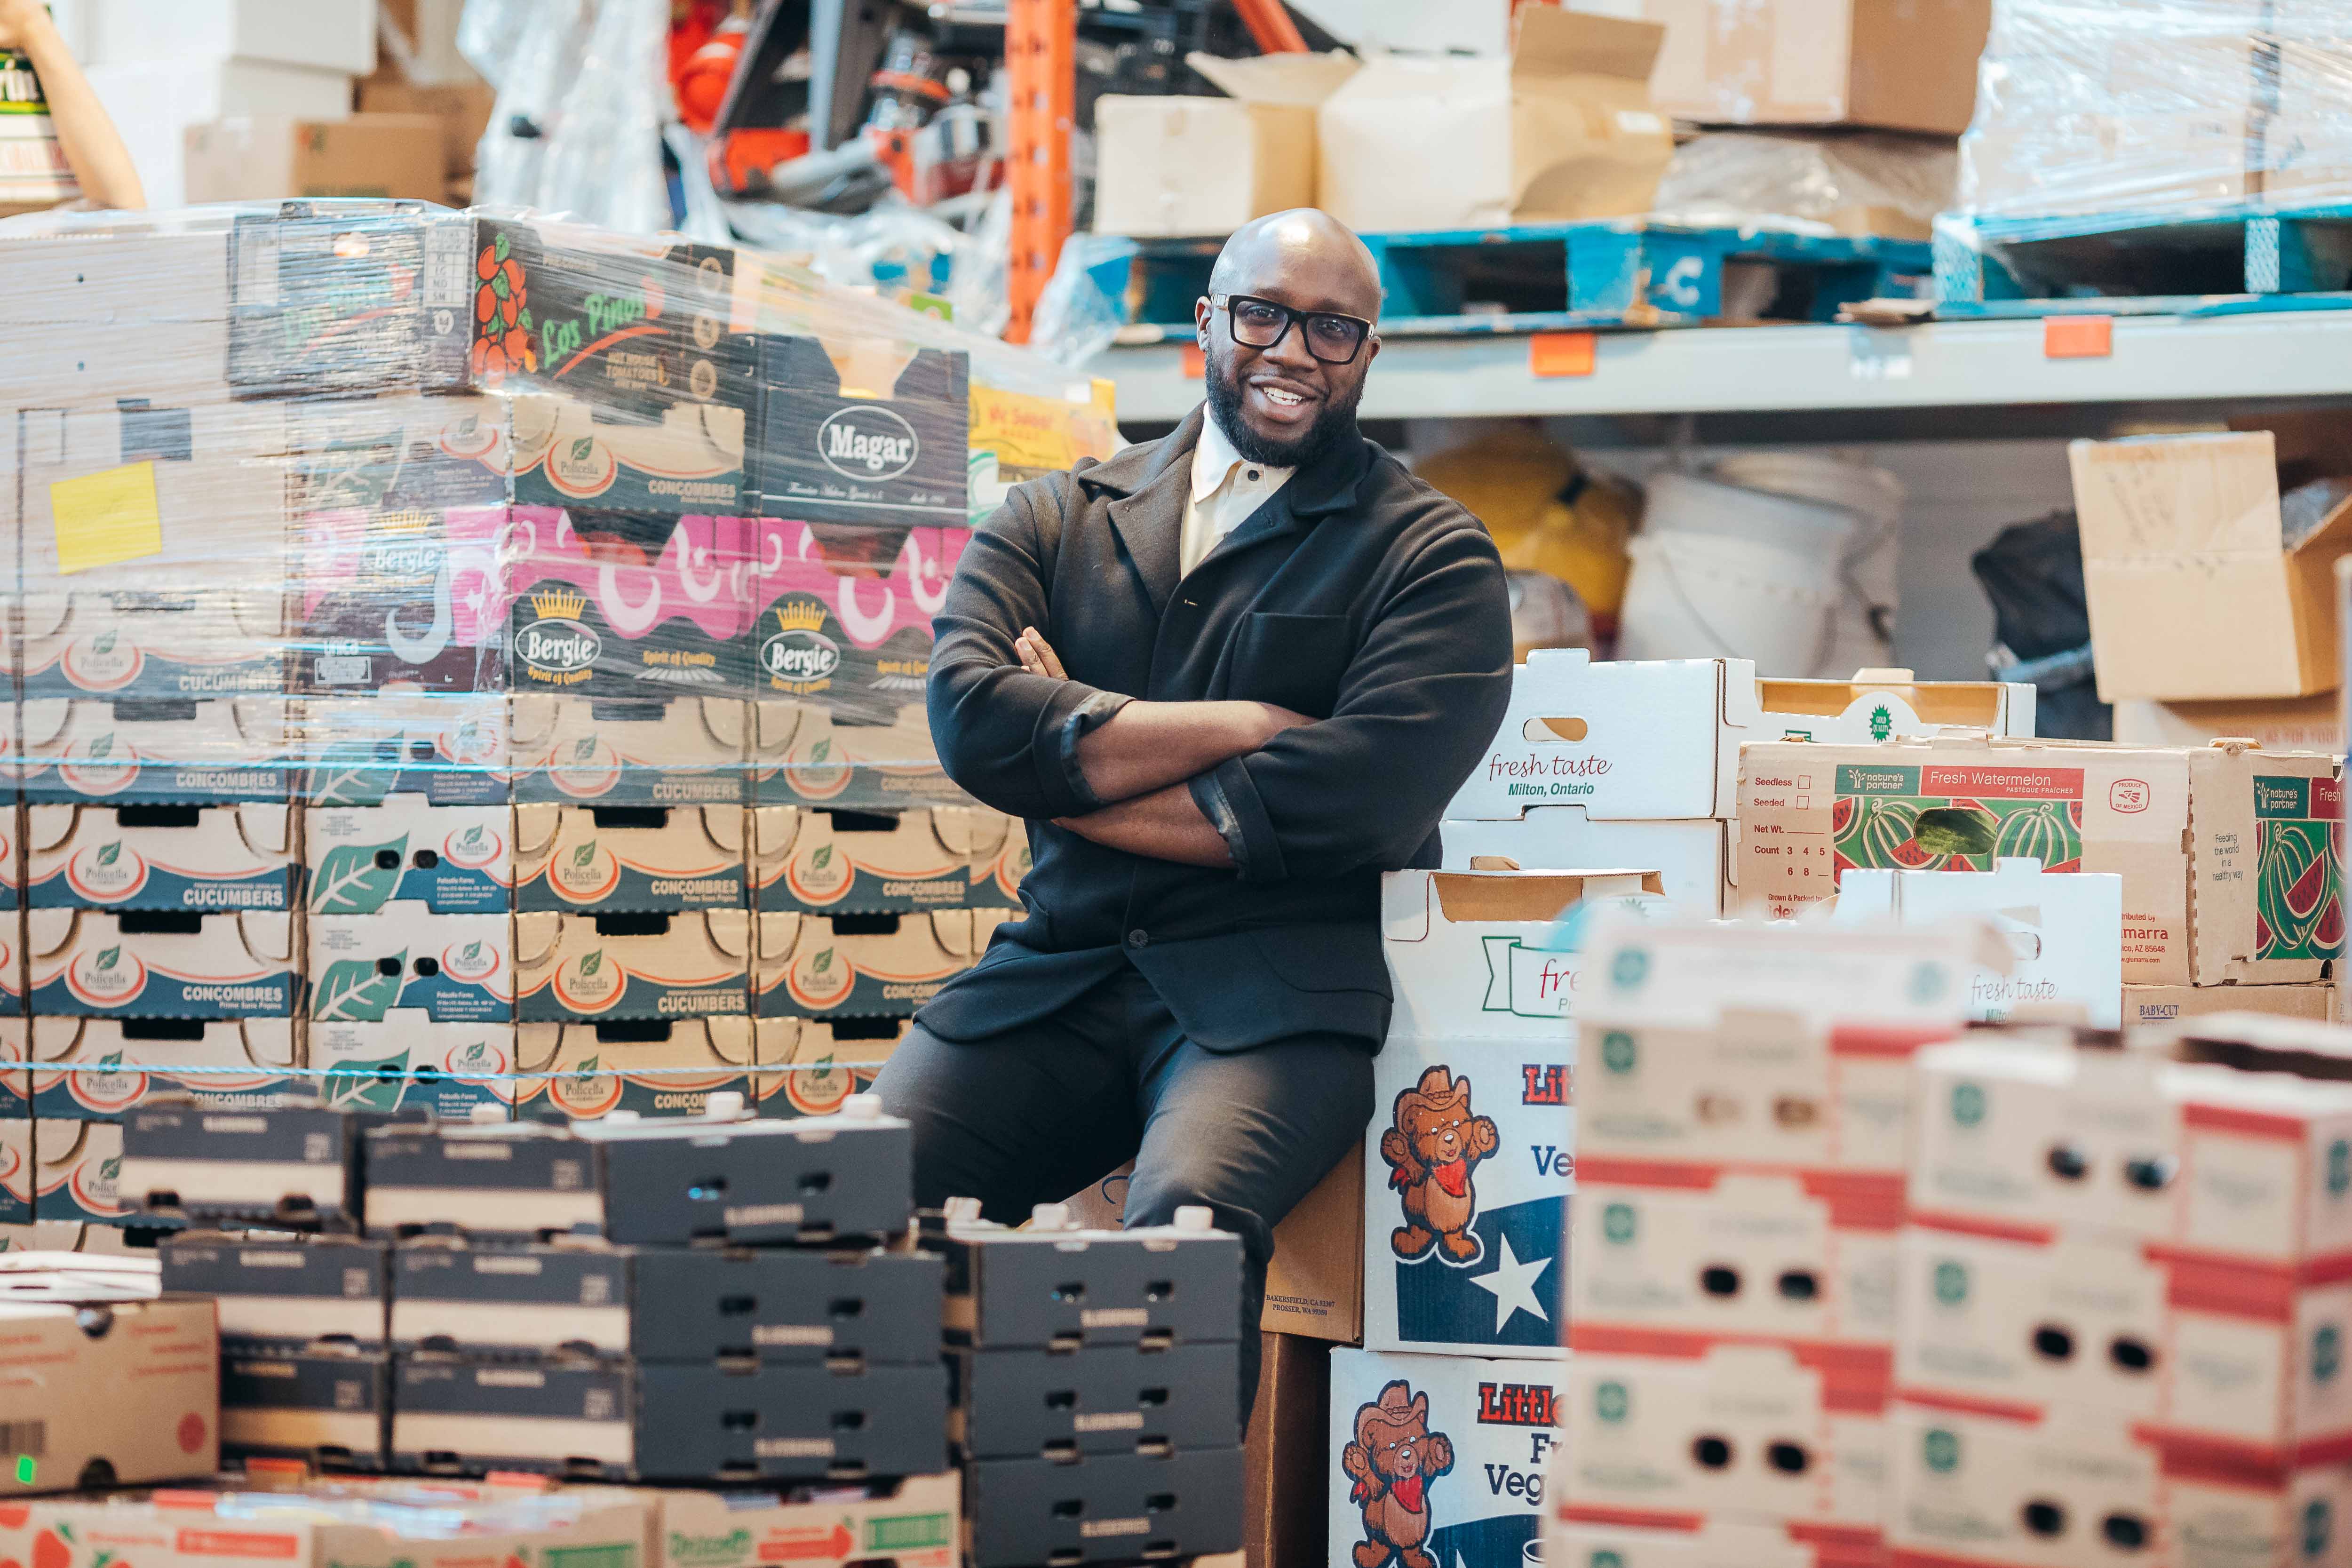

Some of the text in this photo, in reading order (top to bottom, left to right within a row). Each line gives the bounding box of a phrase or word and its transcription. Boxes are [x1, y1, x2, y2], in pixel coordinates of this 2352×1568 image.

[1666, 256, 1703, 305] C
[542, 294, 644, 369] Los Pinos
[829, 424, 911, 470] Magar
[648, 480, 736, 497] CONCOMBRES
[528, 631, 594, 667] Bergie
[771, 642, 834, 677] Bergie
[180, 676, 278, 691] CUCUMBERS
[1489, 753, 1612, 780] fresh taste
[176, 773, 277, 788] CONCOMBRES
[1755, 777, 1792, 787] Seedless
[1867, 773, 1904, 782] nature's
[1931, 772, 2051, 786] Fresh Watermelon
[652, 783, 739, 799] CUCUMBERS
[1509, 782, 1594, 797] Milton, Ontario
[1867, 781, 1903, 790] partner
[2271, 788, 2297, 799] nature's
[2320, 788, 2340, 802] Fresh
[1754, 798, 1785, 807] Seeded
[2271, 799, 2297, 810] partner
[2215, 833, 2237, 843] Feeding
[2215, 844, 2239, 855] the world
[564, 868, 602, 880] Policella
[1804, 868, 1809, 876] 8
[2212, 870, 2243, 882] healthy way
[651, 880, 738, 895] CONCOMBRES
[183, 888, 283, 906] CUCUMBERS
[2122, 928, 2168, 940] marra
[2145, 945, 2165, 953] 85648
[84, 973, 127, 984] Policella
[569, 978, 608, 989] Policella
[183, 986, 282, 1001] CONCOMBRES
[1972, 974, 2058, 1005] fresh taste
[658, 996, 746, 1013] CUCUMBERS
[2139, 1005, 2179, 1016] BABY-CUT
[86, 1077, 128, 1089] Policella
[565, 1083, 604, 1095] Policella
[1531, 1145, 1574, 1176] Ve
[1266, 1294, 1308, 1306] BAKERSFIELD,
[1273, 1304, 1301, 1314] PROSSER,
